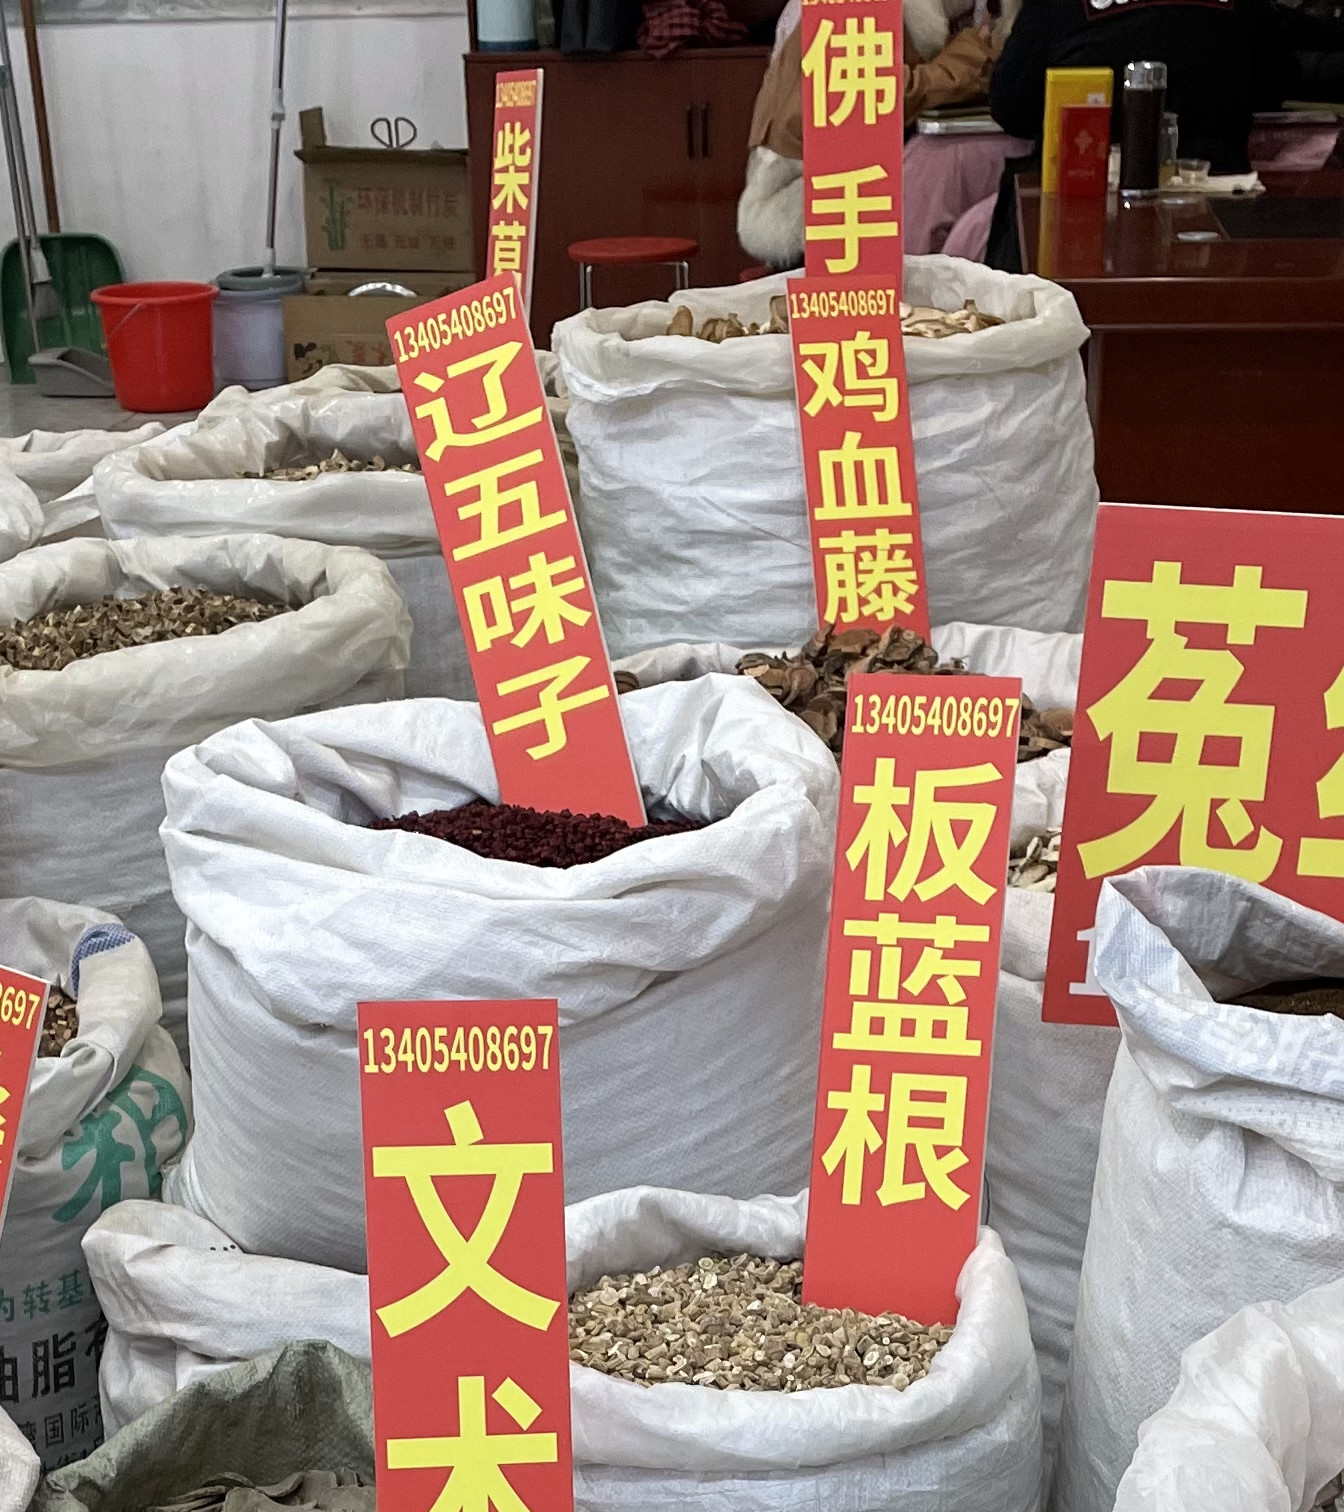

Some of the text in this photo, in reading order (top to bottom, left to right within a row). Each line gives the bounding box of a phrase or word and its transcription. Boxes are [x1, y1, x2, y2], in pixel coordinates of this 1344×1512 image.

[801, 16, 899, 274] 佛手
[394, 286, 518, 363] 13405408697
[791, 290, 894, 318] 13405408697
[415, 341, 609, 760] 辽五味子
[799, 331, 918, 624] 鸡血藤
[852, 695, 1019, 736] 13405408697
[364, 1026, 553, 1073] 13405408697
[822, 758, 1002, 1210] 板蓝根
